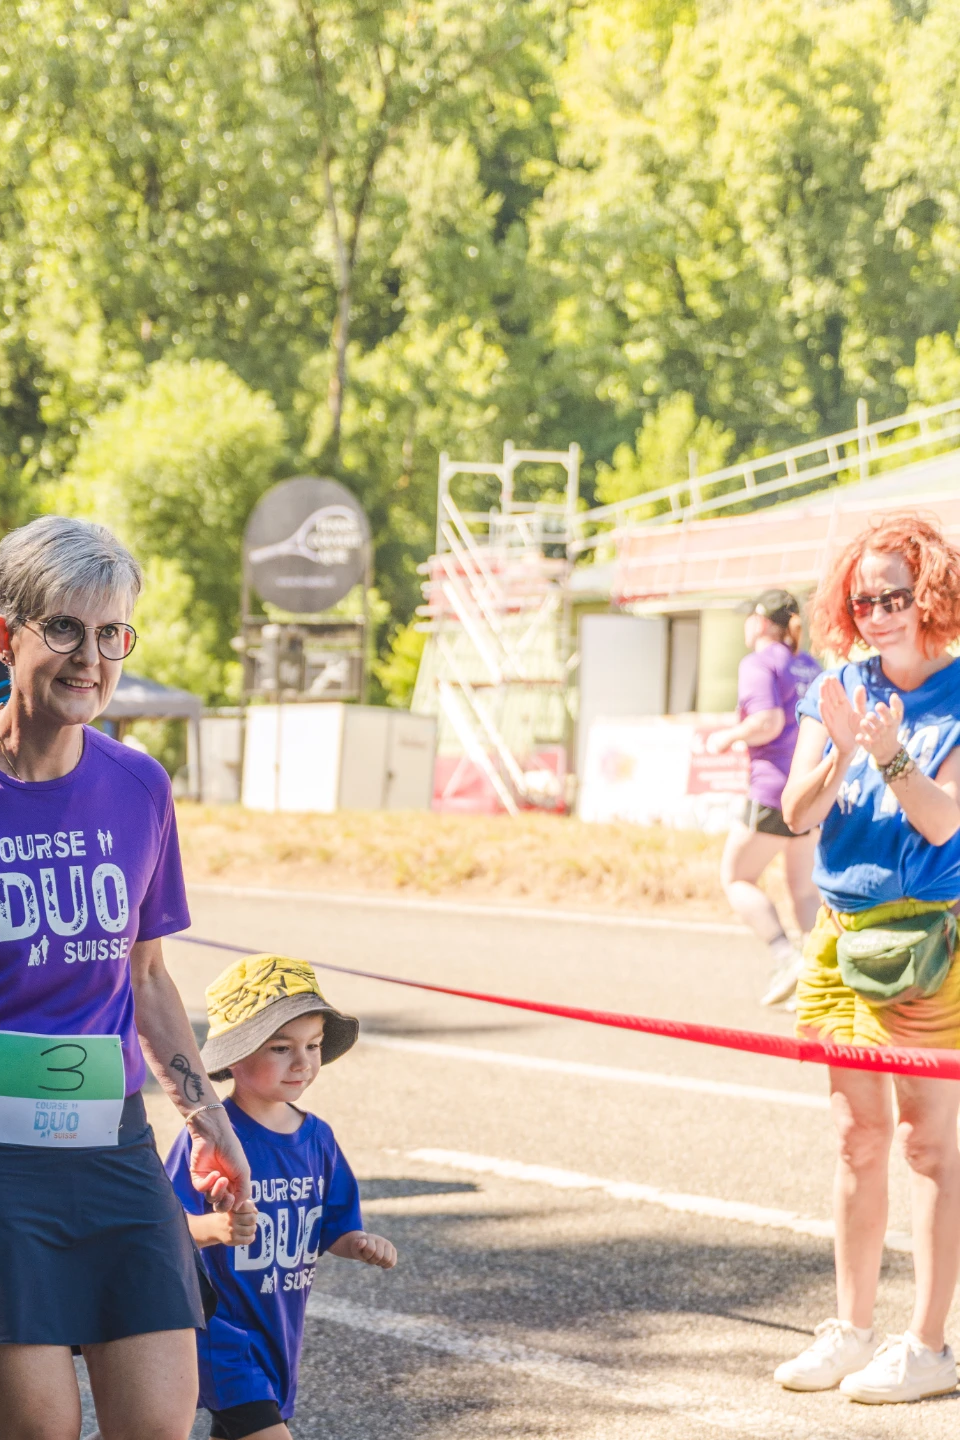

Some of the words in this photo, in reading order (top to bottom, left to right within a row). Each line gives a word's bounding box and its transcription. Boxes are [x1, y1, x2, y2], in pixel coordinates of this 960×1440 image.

[64, 937, 130, 964] SUISSE
[38, 1044, 88, 1091] 3
[822, 1041, 940, 1068] RAIFFEISEN
[35, 1101, 69, 1110] COURSE
[33, 1111, 80, 1132] DUO
[249, 1176, 314, 1203] OURSE
